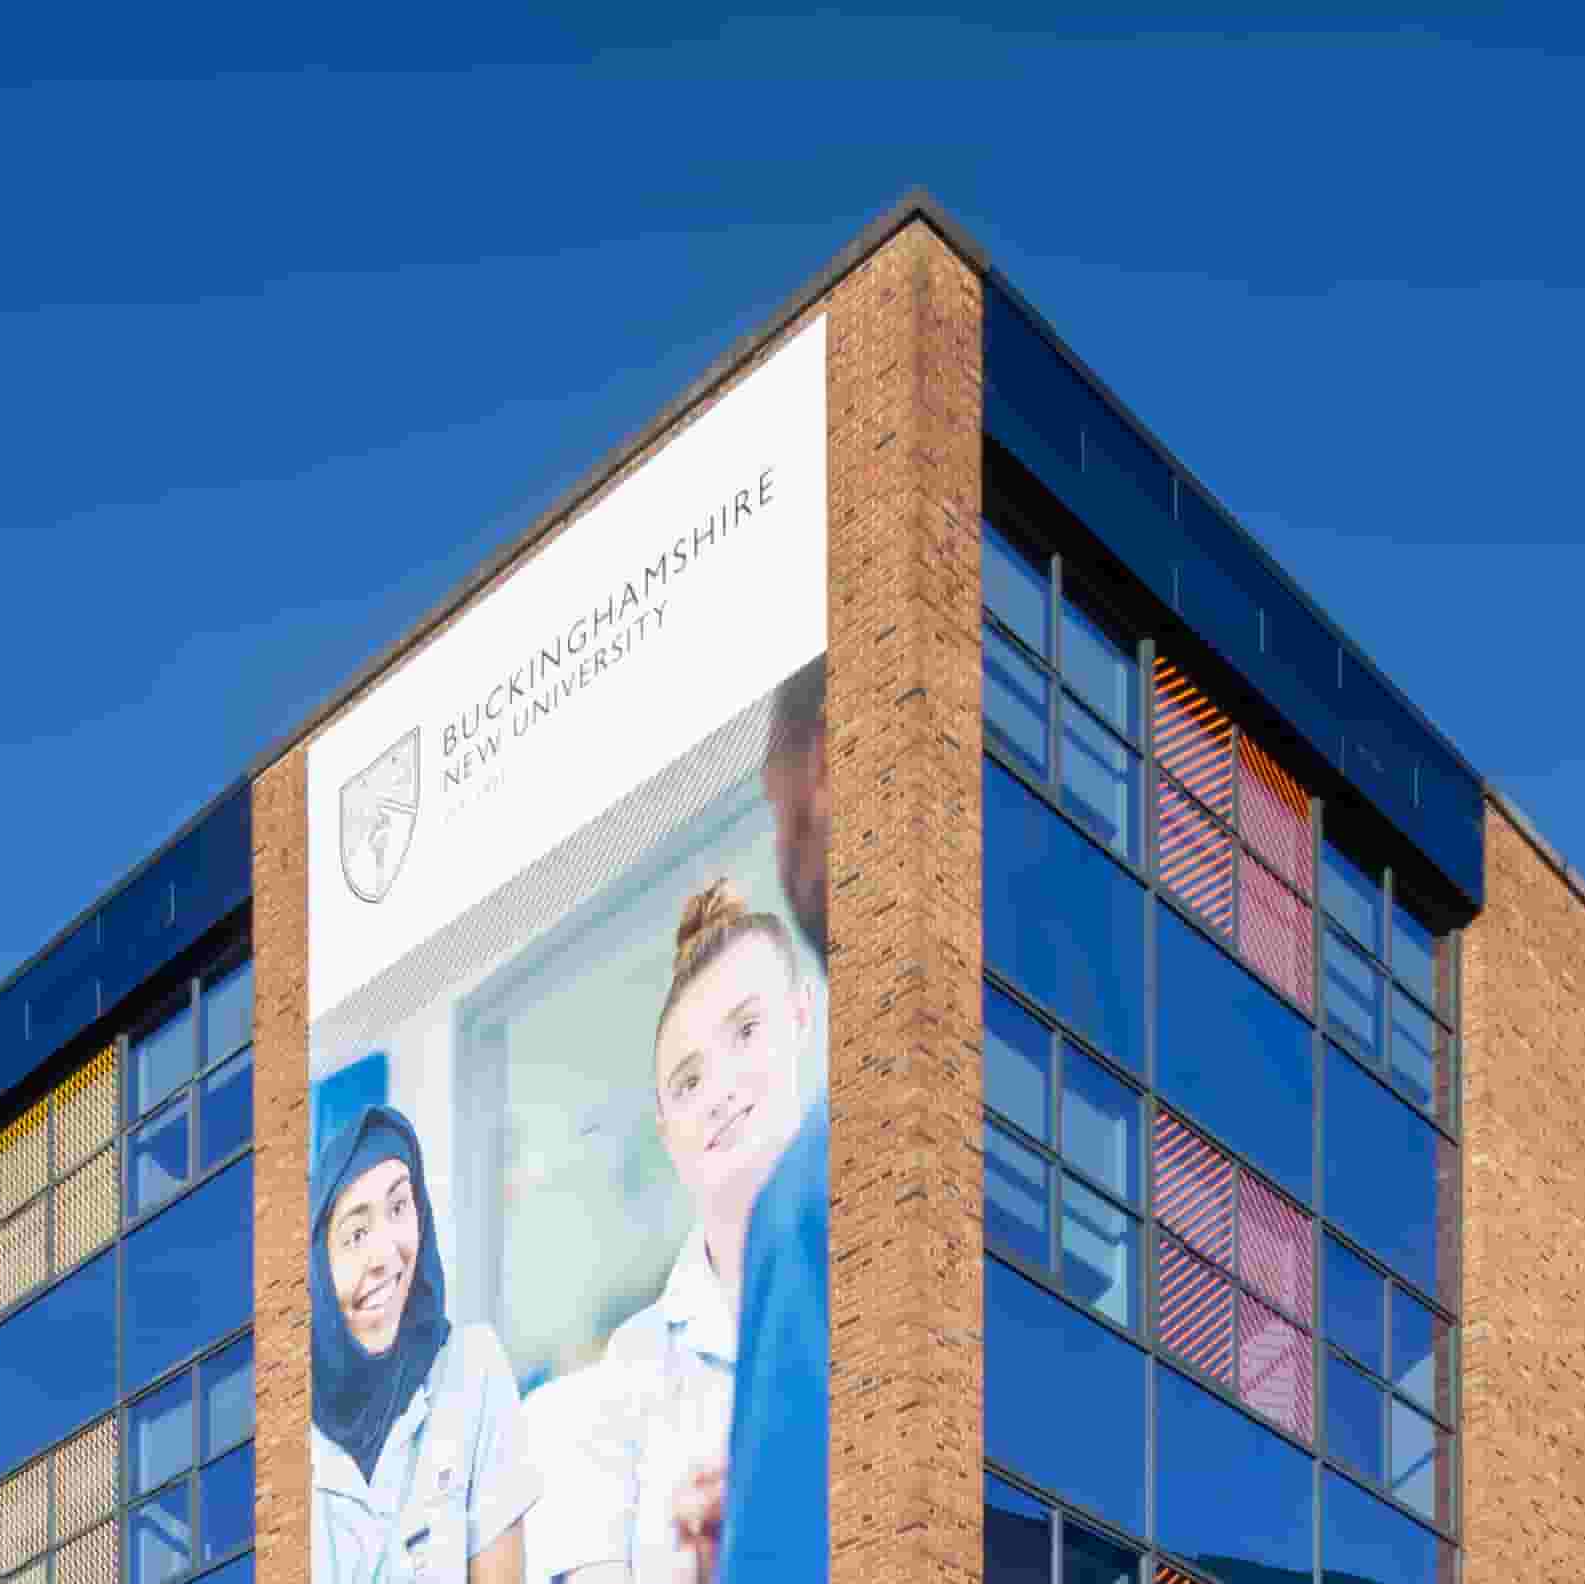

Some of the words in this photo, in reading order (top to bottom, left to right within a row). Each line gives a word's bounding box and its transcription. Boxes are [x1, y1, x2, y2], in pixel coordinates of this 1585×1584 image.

[441, 465, 776, 757] BUCKINGHAMSHIRE
[442, 729, 502, 793] NEW
[512, 600, 669, 737] UNIVERSITY
